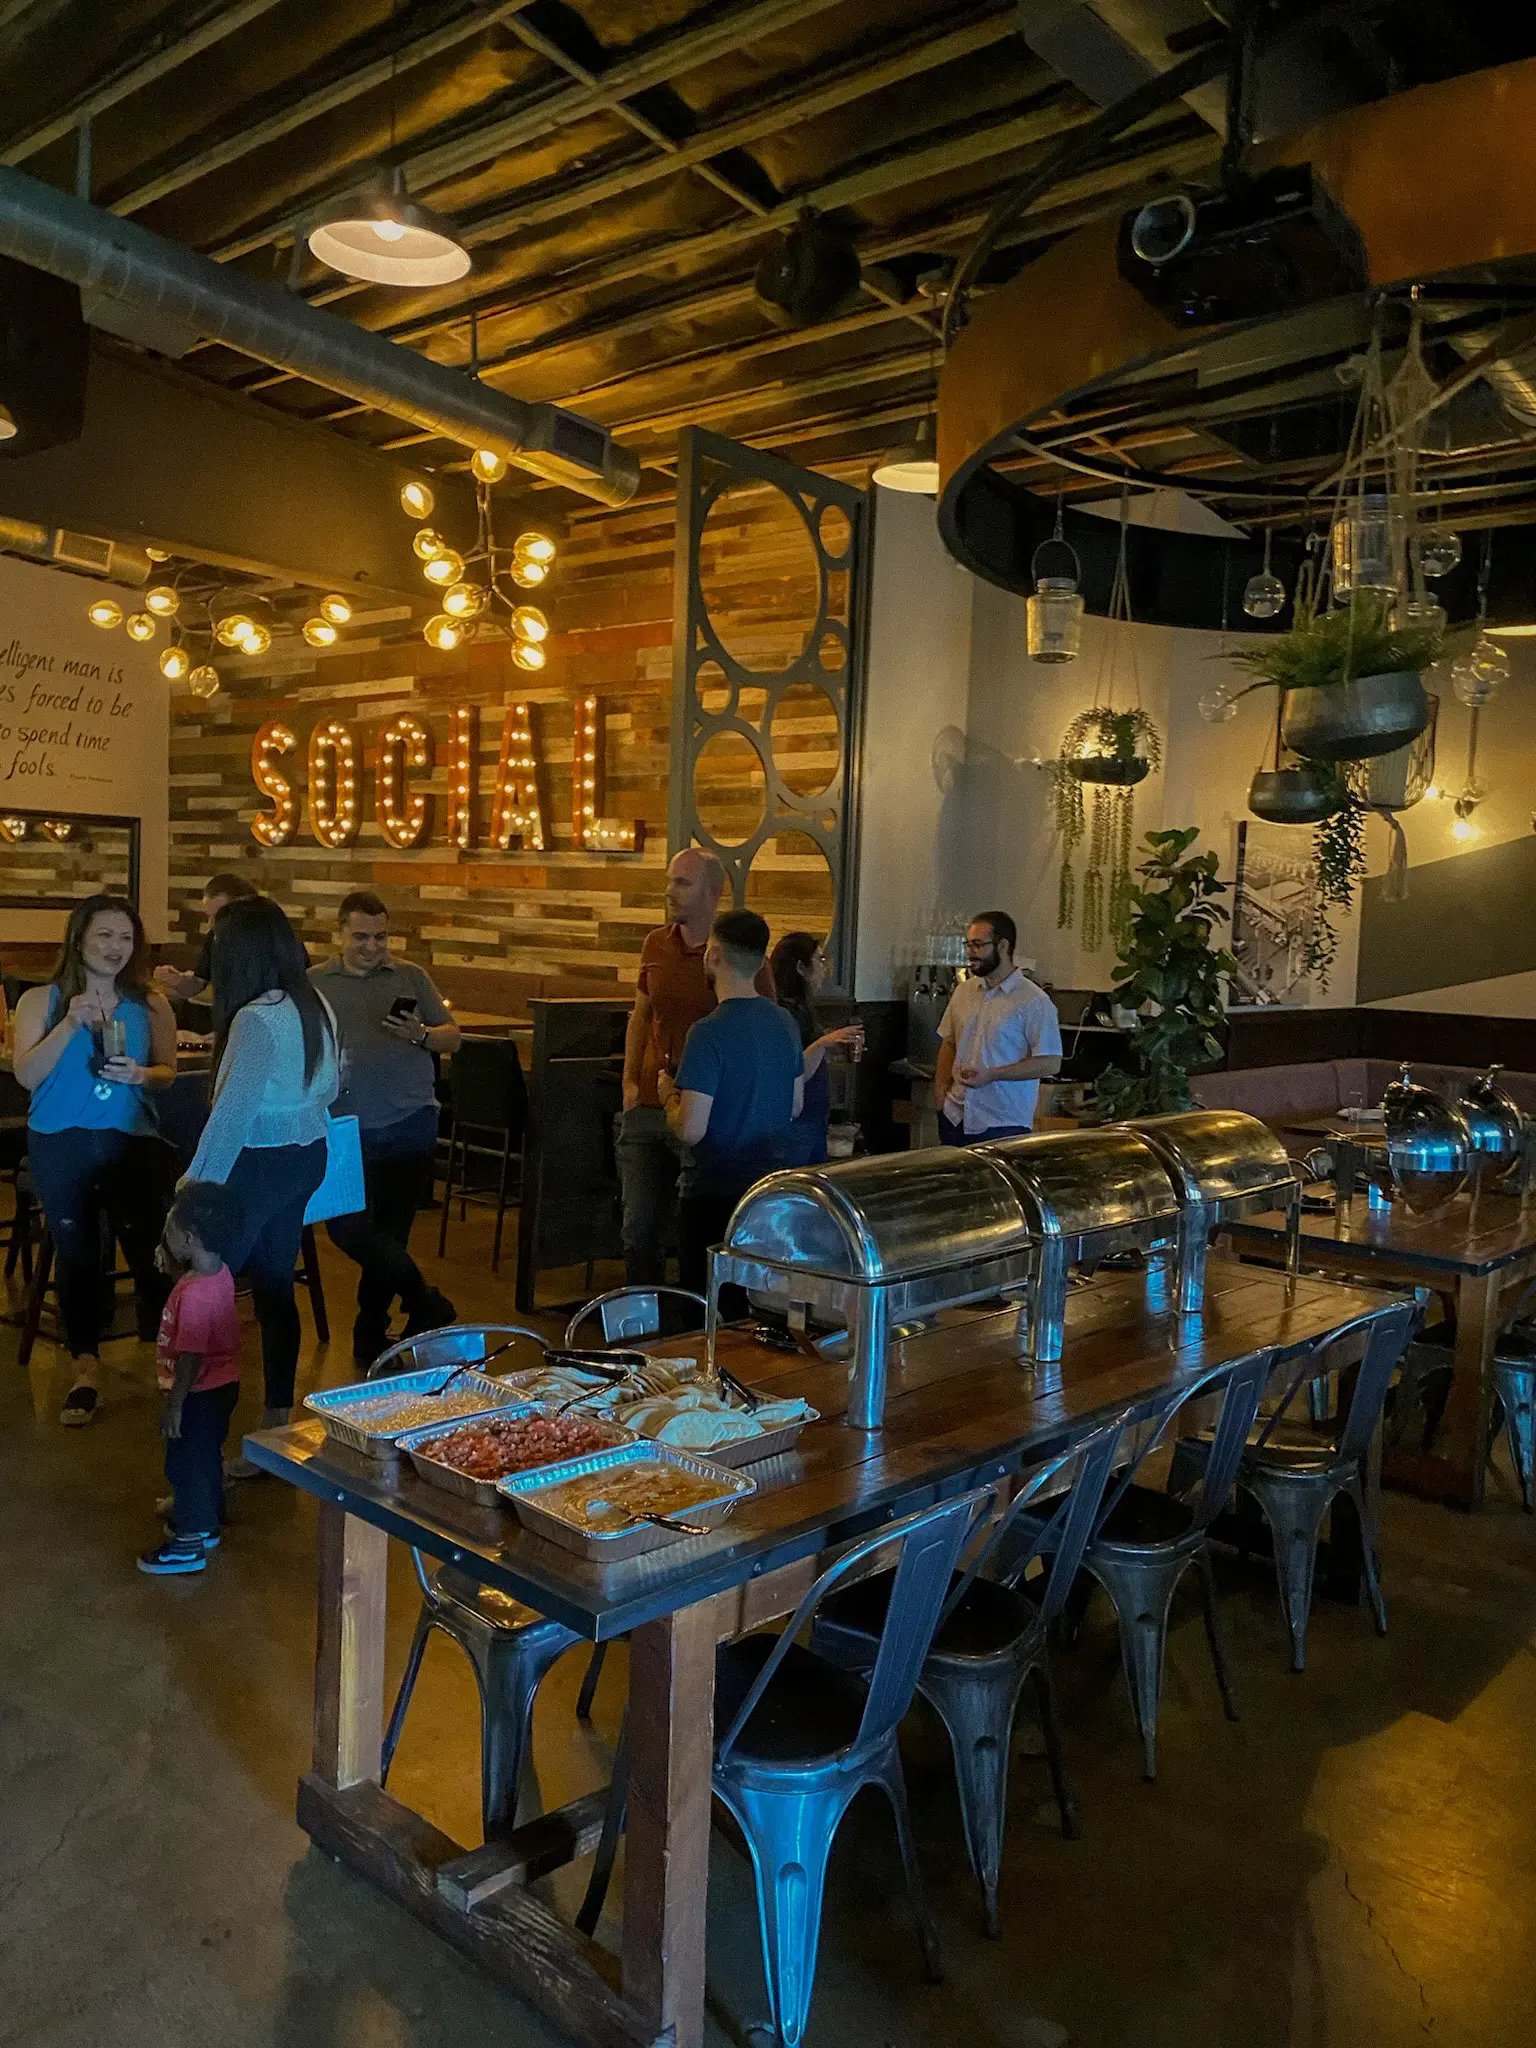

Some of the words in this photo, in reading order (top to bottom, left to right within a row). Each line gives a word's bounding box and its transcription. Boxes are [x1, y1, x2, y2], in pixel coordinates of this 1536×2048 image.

[63, 659, 101, 680] man
[108, 662, 124, 684] is
[23, 682, 84, 714] forced
[87, 696, 103, 714] to
[110, 693, 132, 718] be
[18, 721, 72, 751] spend
[76, 733, 111, 751] time
[251, 695, 637, 852] SOCIAL
